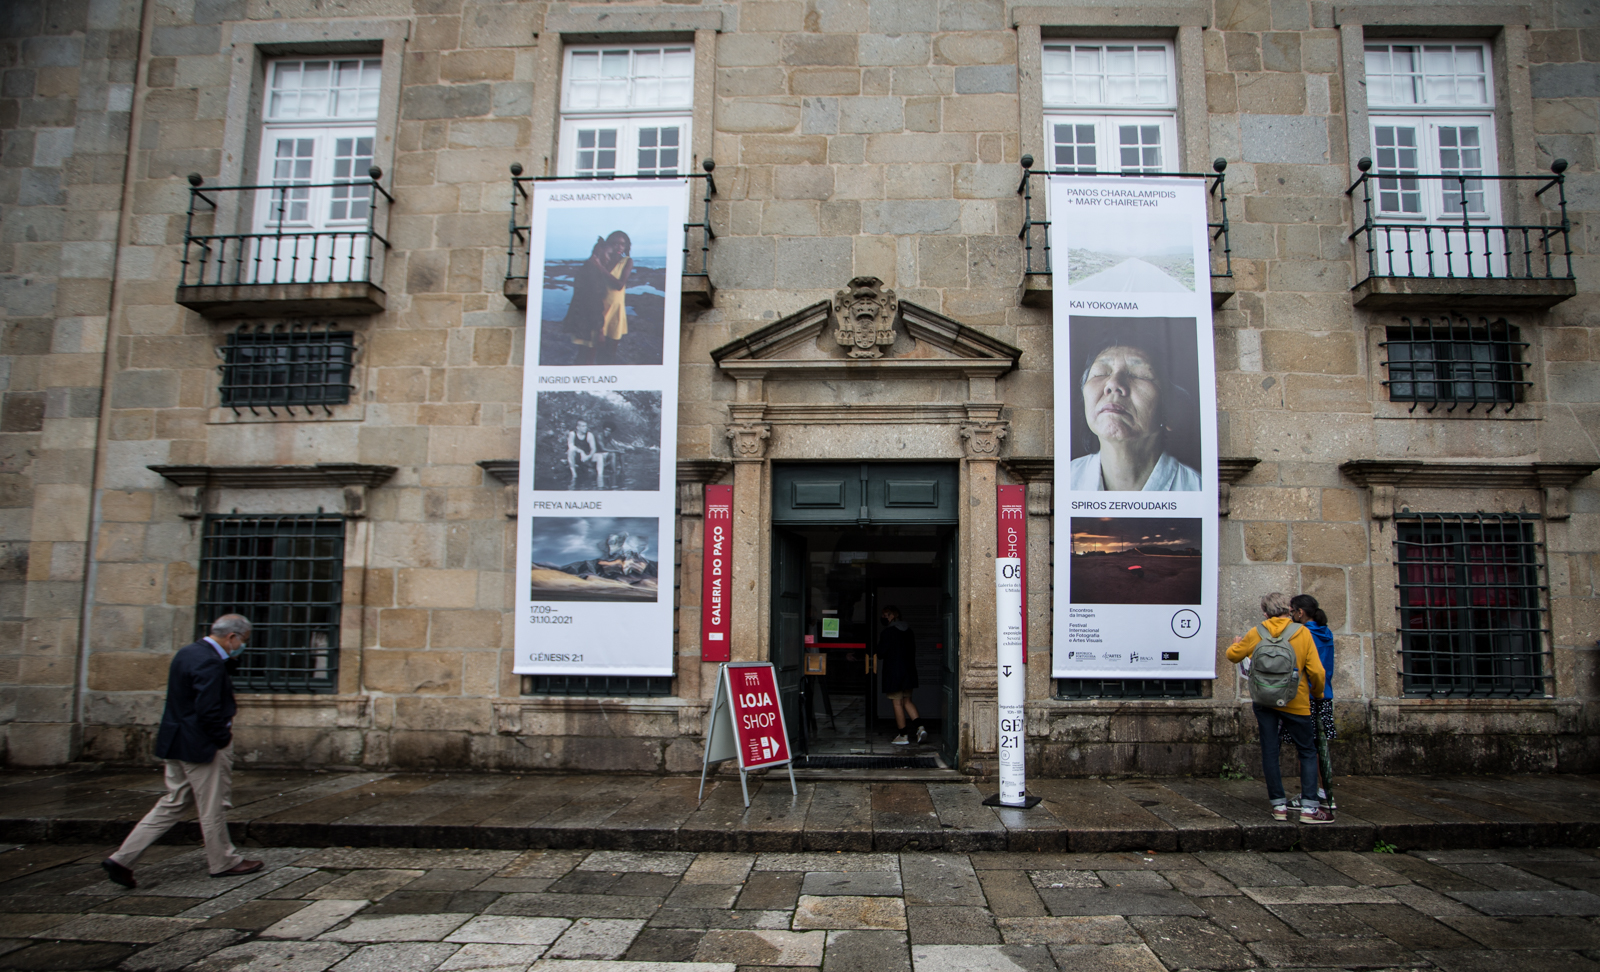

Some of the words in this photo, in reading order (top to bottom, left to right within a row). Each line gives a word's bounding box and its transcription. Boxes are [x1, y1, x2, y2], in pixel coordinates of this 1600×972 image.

[549, 194, 575, 202] ALISA
[576, 192, 633, 201] MARTYNOVA
[1067, 188, 1099, 196] PANOS
[1100, 190, 1176, 198] CHARALAMPIDIS
[1104, 198, 1158, 207] CHAIRETAKI
[1070, 300, 1085, 308] KAI
[1087, 301, 1138, 310] YOKOYAMA
[538, 376, 571, 384] INGRID
[572, 375, 618, 384] WEYLAND
[1072, 501, 1107, 510] SPIROS
[1108, 502, 1177, 510] ZERVOUDAKIS
[714, 526, 724, 556] PAÇO
[1008, 527, 1018, 558] SHOP
[713, 558, 722, 576] DO
[712, 578, 722, 625] GALERIA
[530, 616, 573, 624] 31.10.2021
[530, 652, 570, 662] GÉNESIS
[572, 654, 584, 662] 2:1
[739, 692, 772, 708] LOJA
[743, 712, 776, 730] SHOP
[1001, 735, 1018, 748] 2:1
